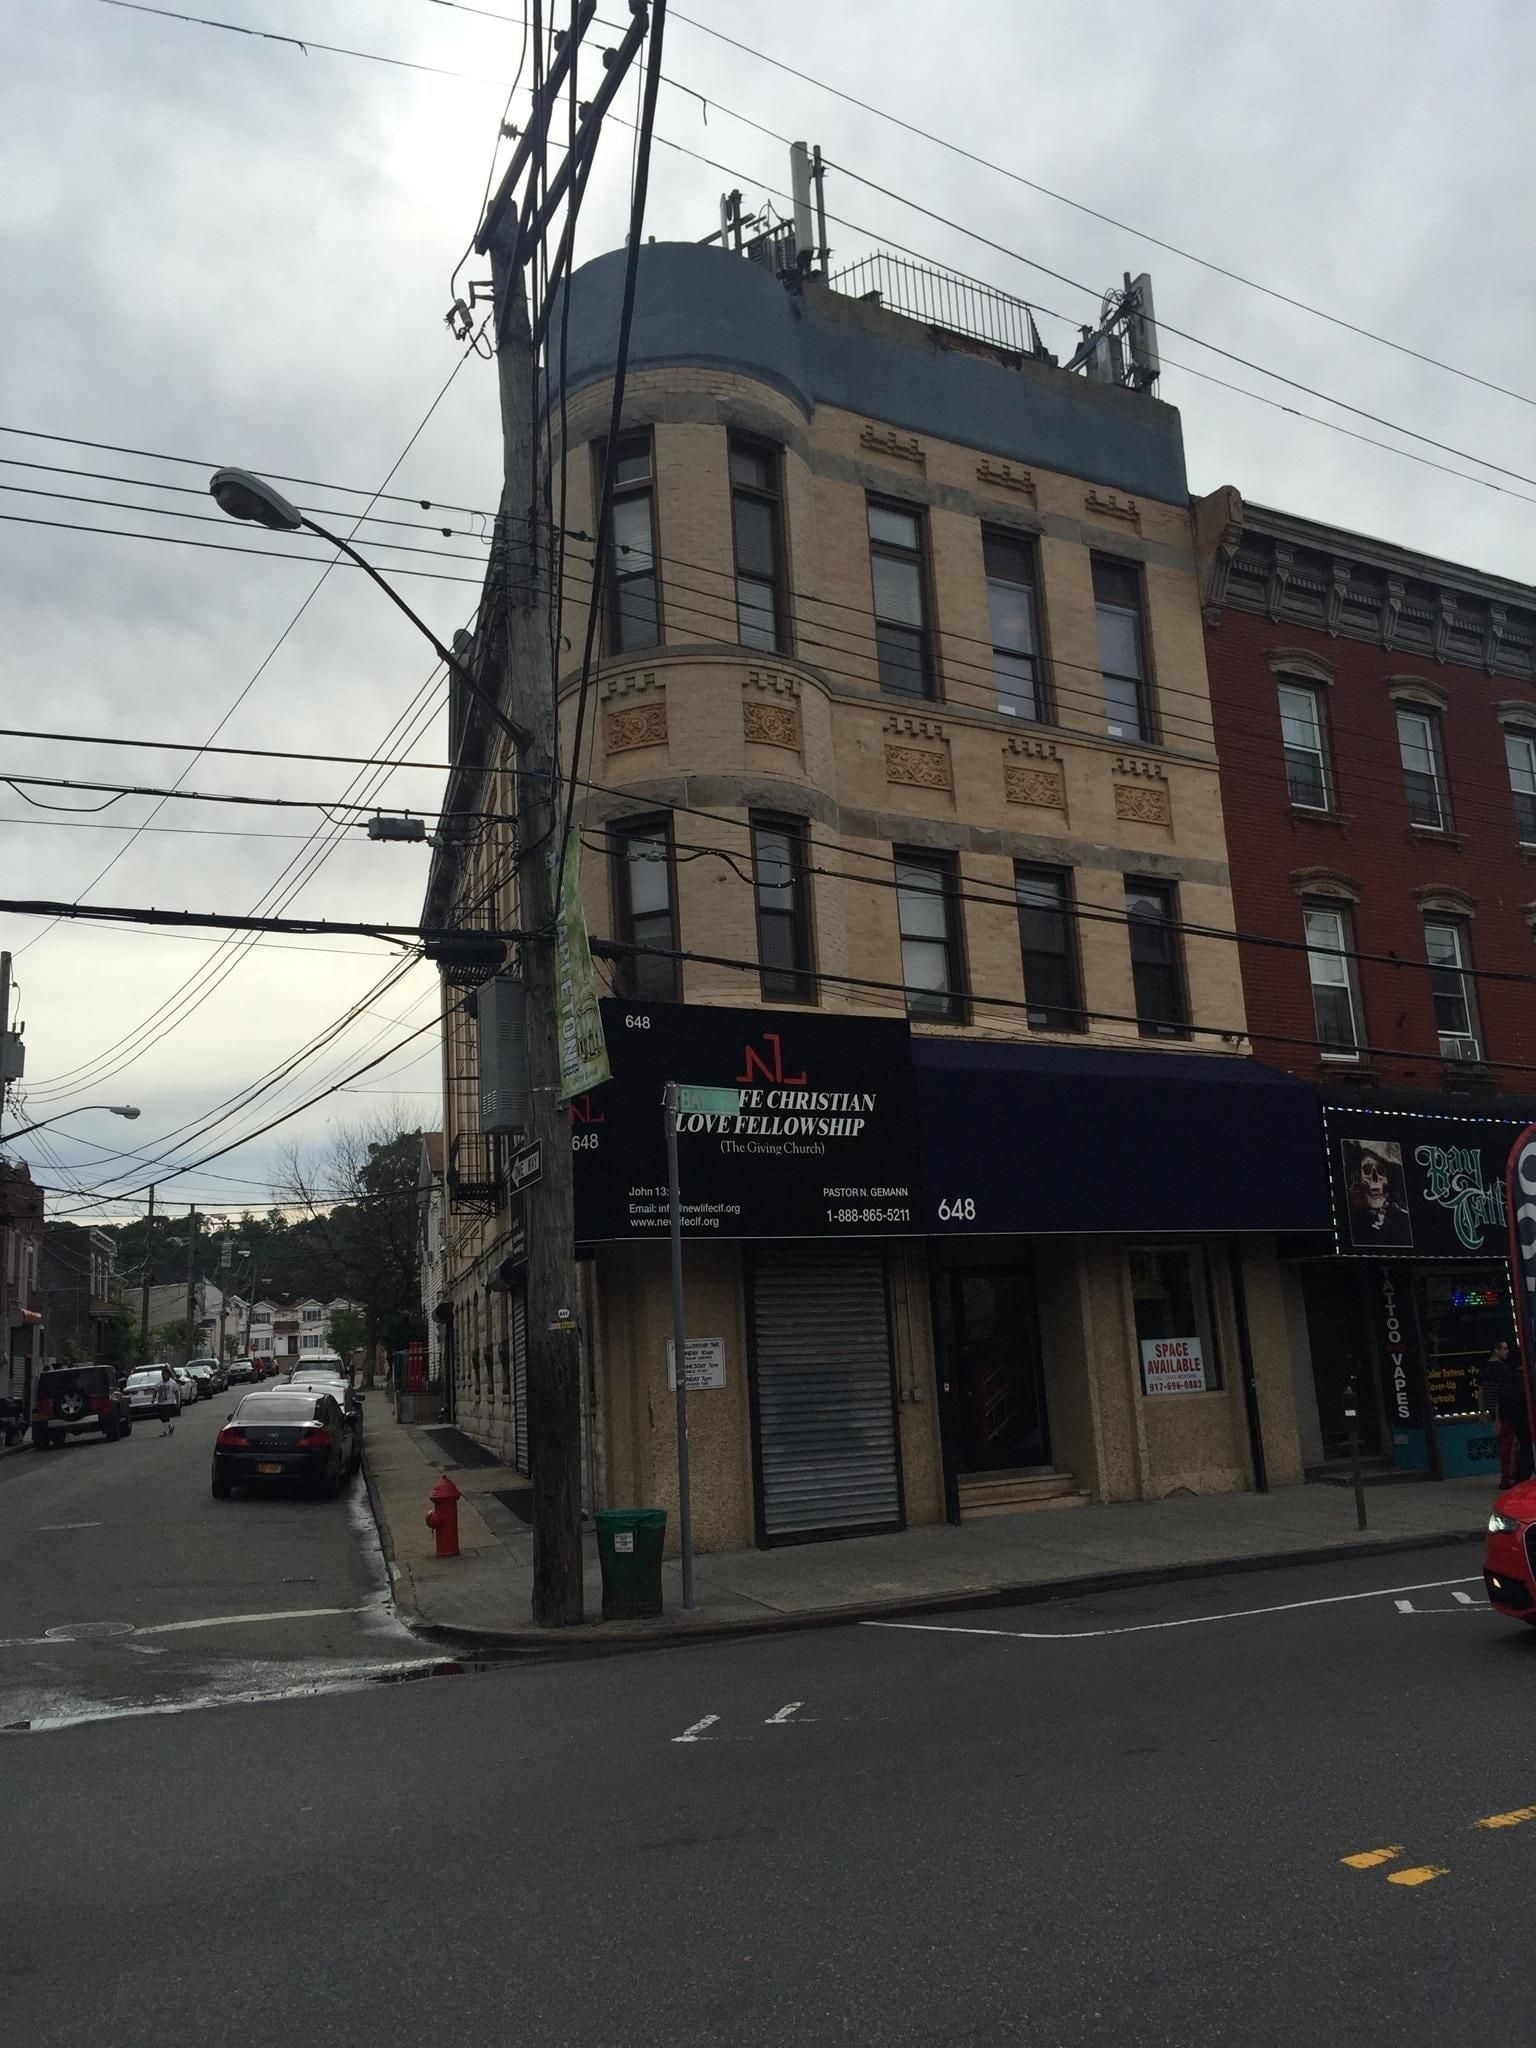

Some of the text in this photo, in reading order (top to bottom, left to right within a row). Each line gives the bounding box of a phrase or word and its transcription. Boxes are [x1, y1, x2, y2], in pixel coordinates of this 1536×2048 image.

[625, 1015, 651, 1030] 648
[739, 1089, 764, 1109] FE
[767, 1090, 877, 1113] CHRISTIAN
[676, 1113, 866, 1137] LOVE FELLOWSHIP
[571, 1134, 599, 1151] 648
[720, 1140, 826, 1156] (The Giving Church)
[1414, 1145, 1484, 1201] Bay
[628, 1186, 653, 1197] John
[823, 1187, 858, 1197] PASTOR
[870, 1187, 909, 1197] GEMANN
[629, 1203, 657, 1214] Email:
[826, 1208, 911, 1223] 1-888-865-5211
[937, 1198, 977, 1221] 648
[1381, 1266, 1401, 1343] TATTOO
[1155, 1342, 1189, 1357] SPACE
[1148, 1358, 1201, 1374] AVAILABLE
[1391, 1353, 1411, 1419] VAPES
